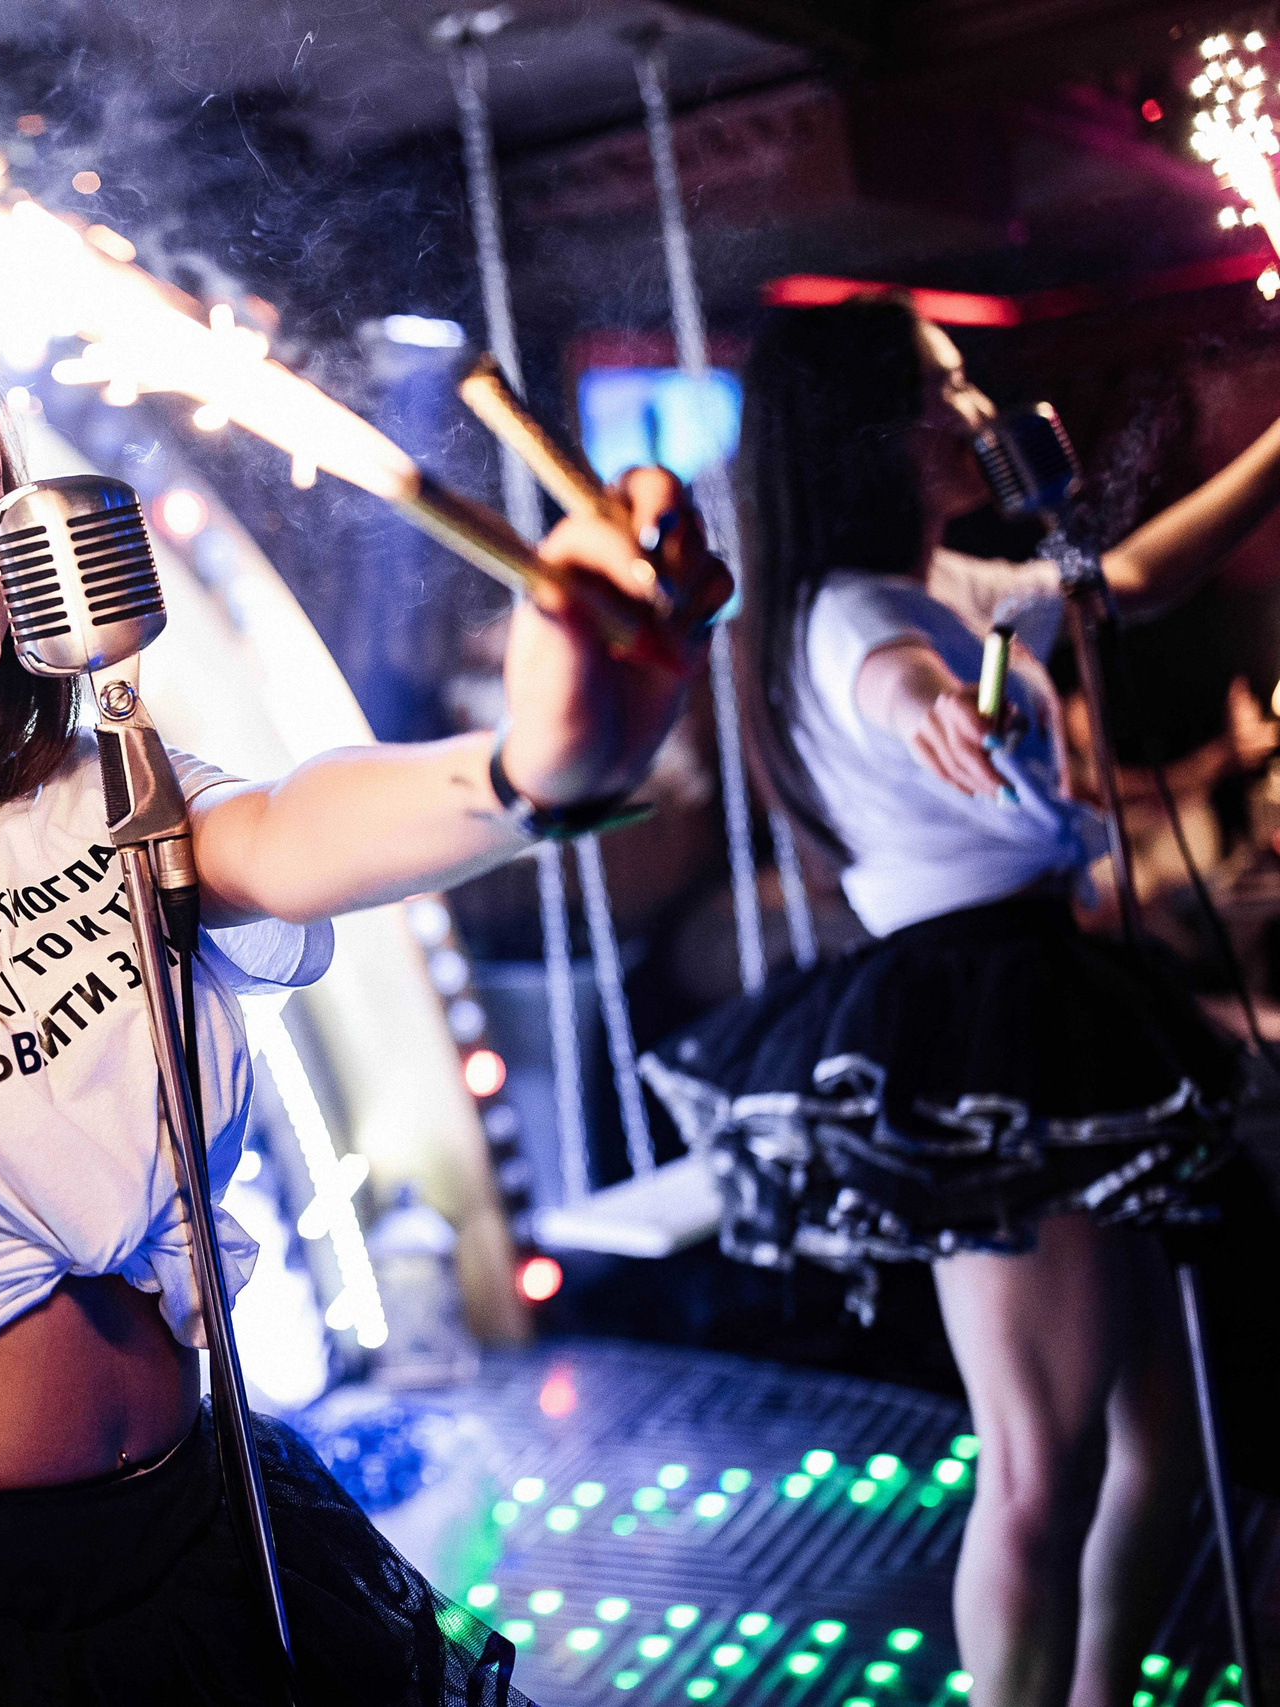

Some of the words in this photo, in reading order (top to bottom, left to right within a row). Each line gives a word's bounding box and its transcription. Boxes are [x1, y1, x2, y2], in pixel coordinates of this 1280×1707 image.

[12, 932, 73, 976] ТО
[66, 914, 111, 942] И
[98, 882, 132, 924] Т
[107, 942, 142, 990] З
